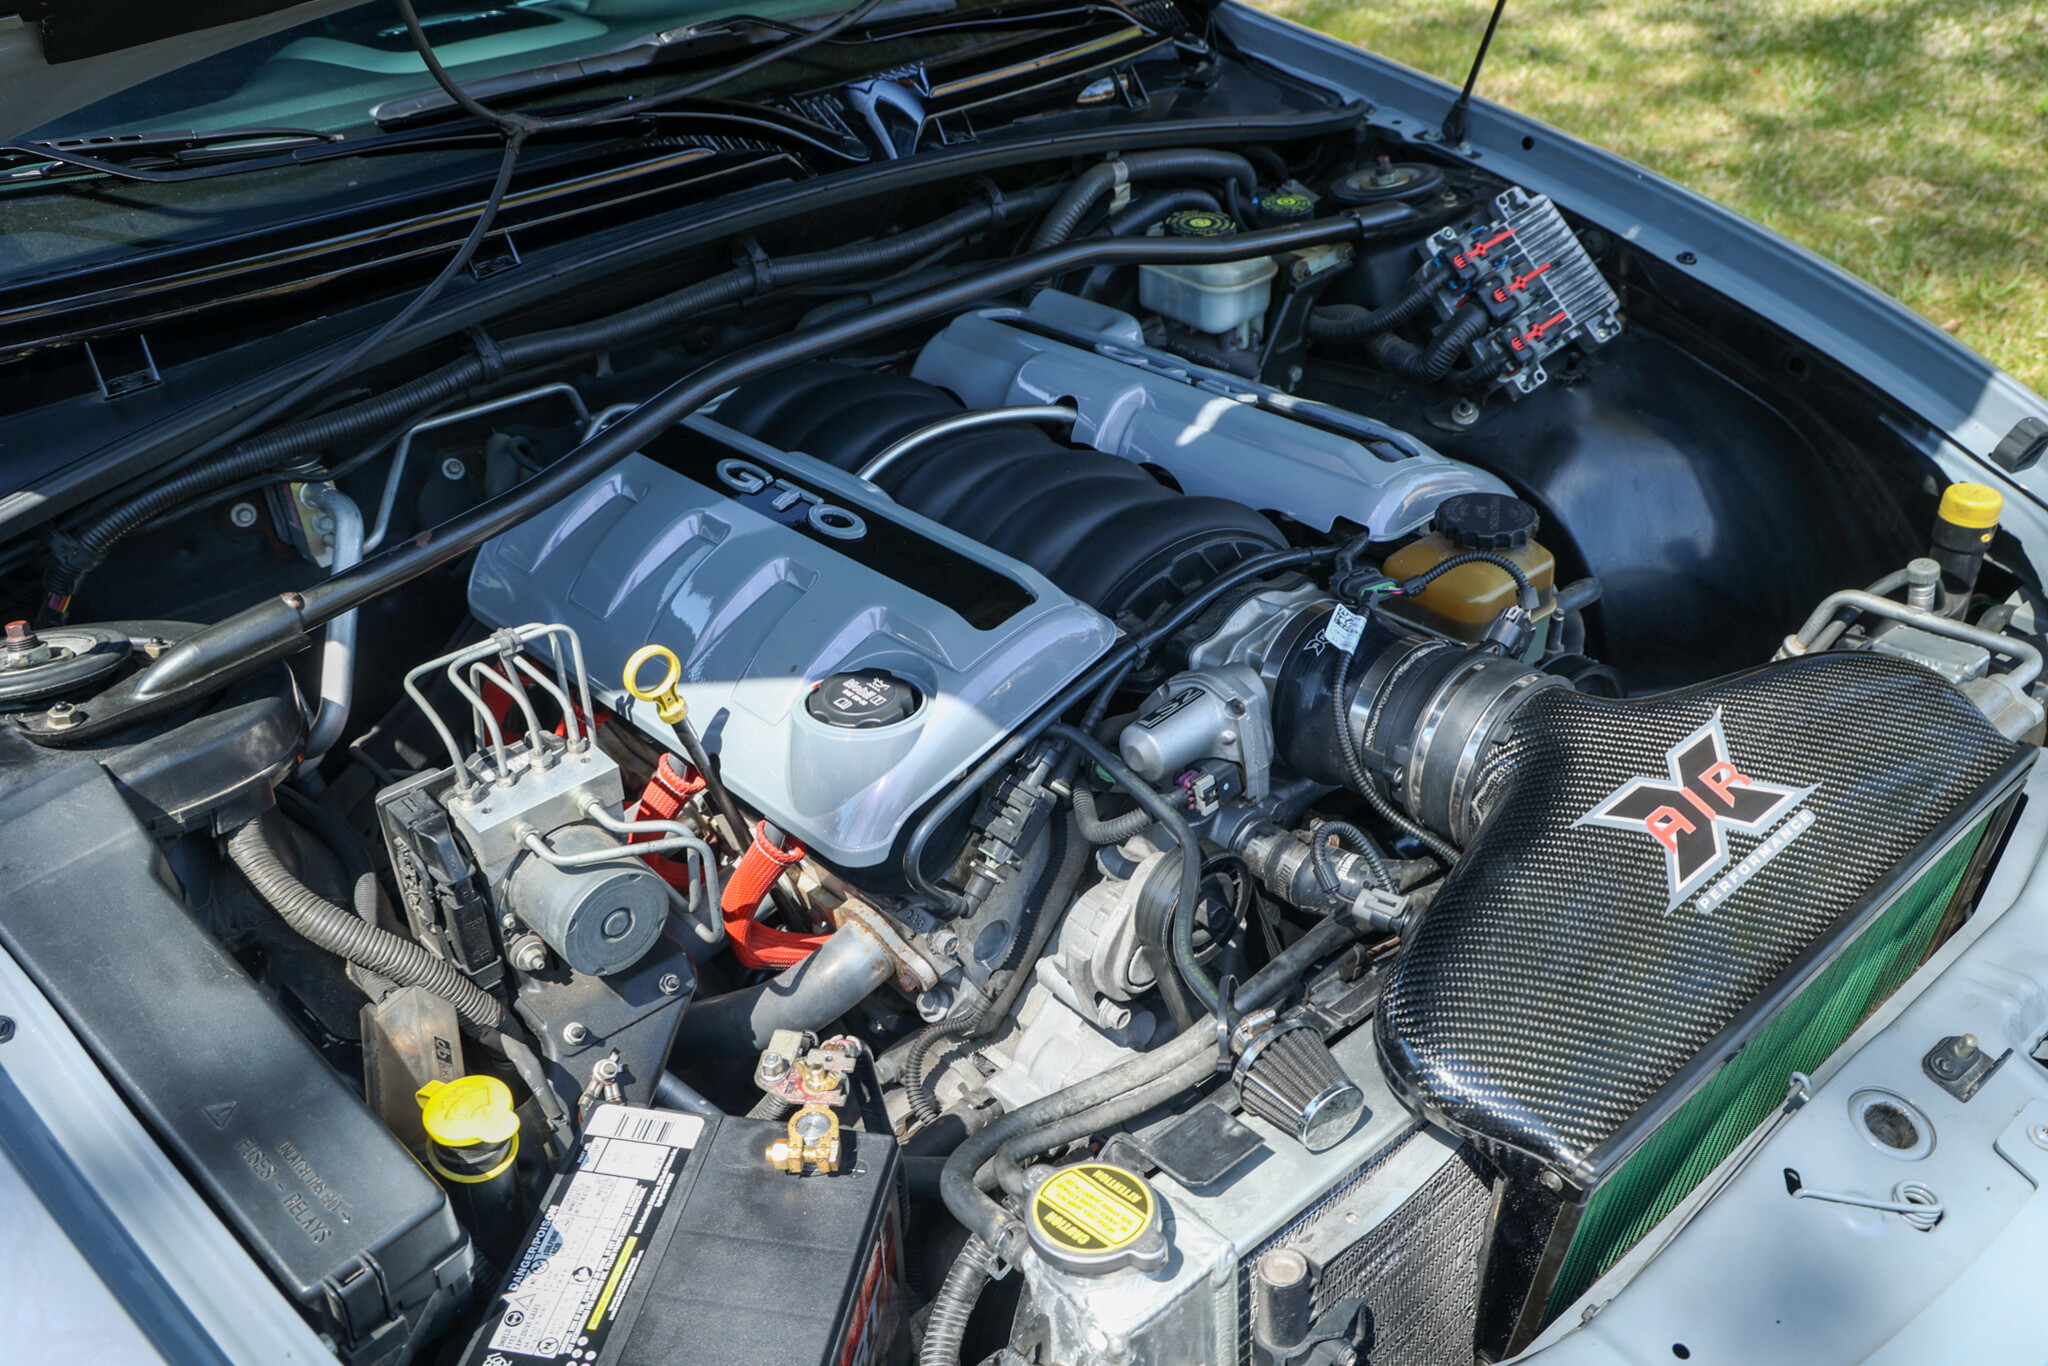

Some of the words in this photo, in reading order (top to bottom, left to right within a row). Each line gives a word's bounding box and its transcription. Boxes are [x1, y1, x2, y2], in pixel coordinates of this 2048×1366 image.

[716, 458, 868, 540] GTO
[1137, 686, 1201, 727] LS2
[1699, 811, 1812, 910] PERFORMANCE
[236, 1138, 278, 1181] FUSES
[282, 1192, 332, 1244] RELAYS
[1043, 1210, 1091, 1245] CAUTION
[1092, 1169, 1141, 1204] ATTENTION
[509, 1205, 560, 1291] DANGER/POISON
